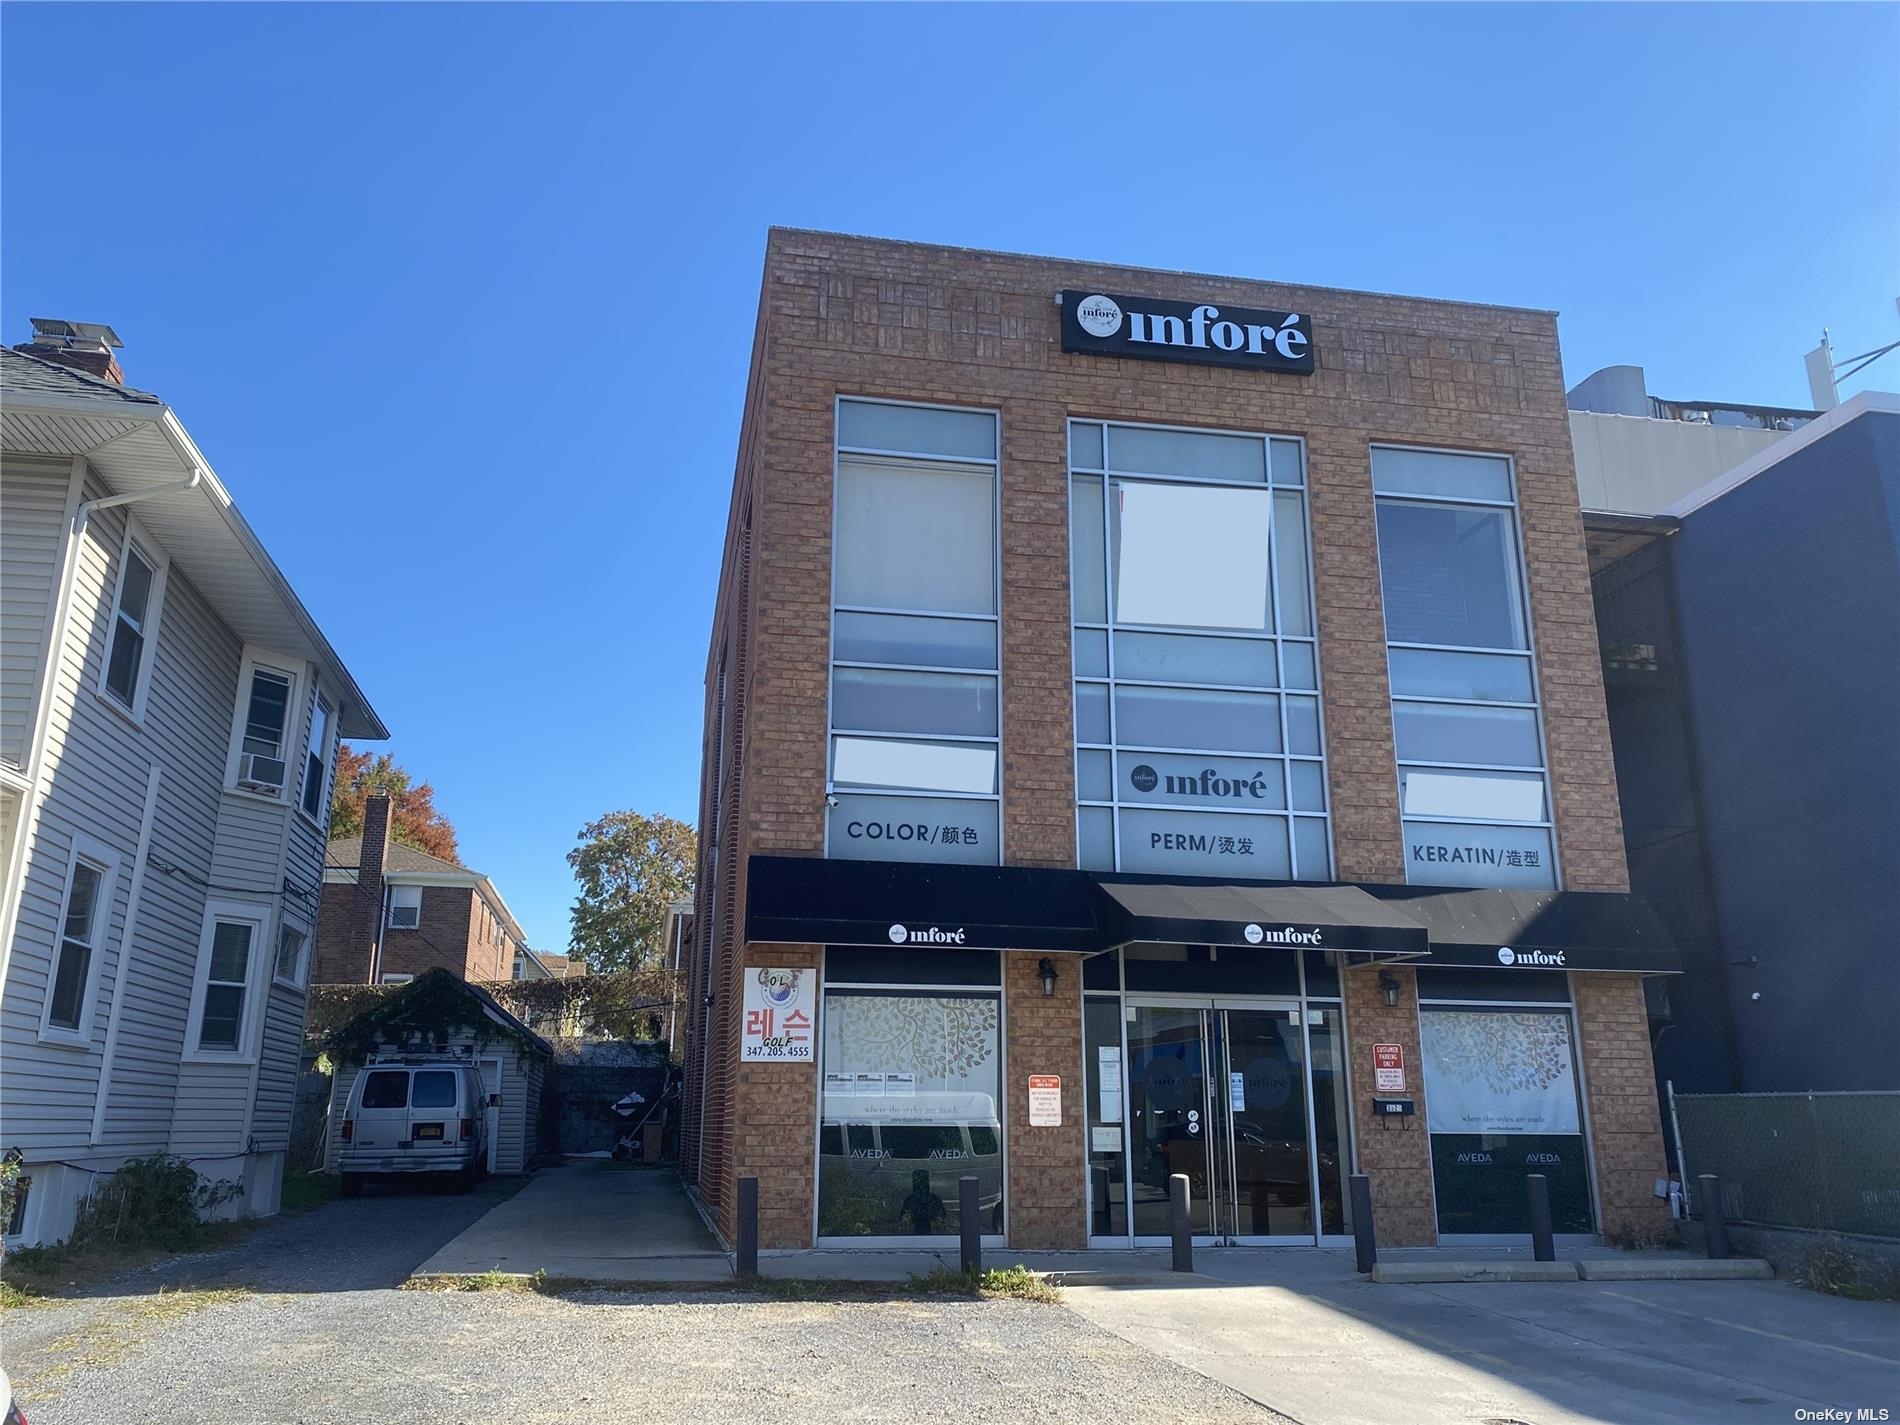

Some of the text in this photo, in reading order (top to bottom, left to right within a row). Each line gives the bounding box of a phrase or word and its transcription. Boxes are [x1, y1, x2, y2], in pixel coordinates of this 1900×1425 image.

[1127, 305, 1308, 359] inforé
[763, 1037, 794, 1047] GOLF
[746, 1046, 809, 1057] 347.205.4555
[850, 1149, 892, 1159] AVEDA
[929, 1150, 970, 1159] AVEDA
[1457, 1153, 1493, 1163] AVEDA
[1526, 1153, 1561, 1163] AVEDA
